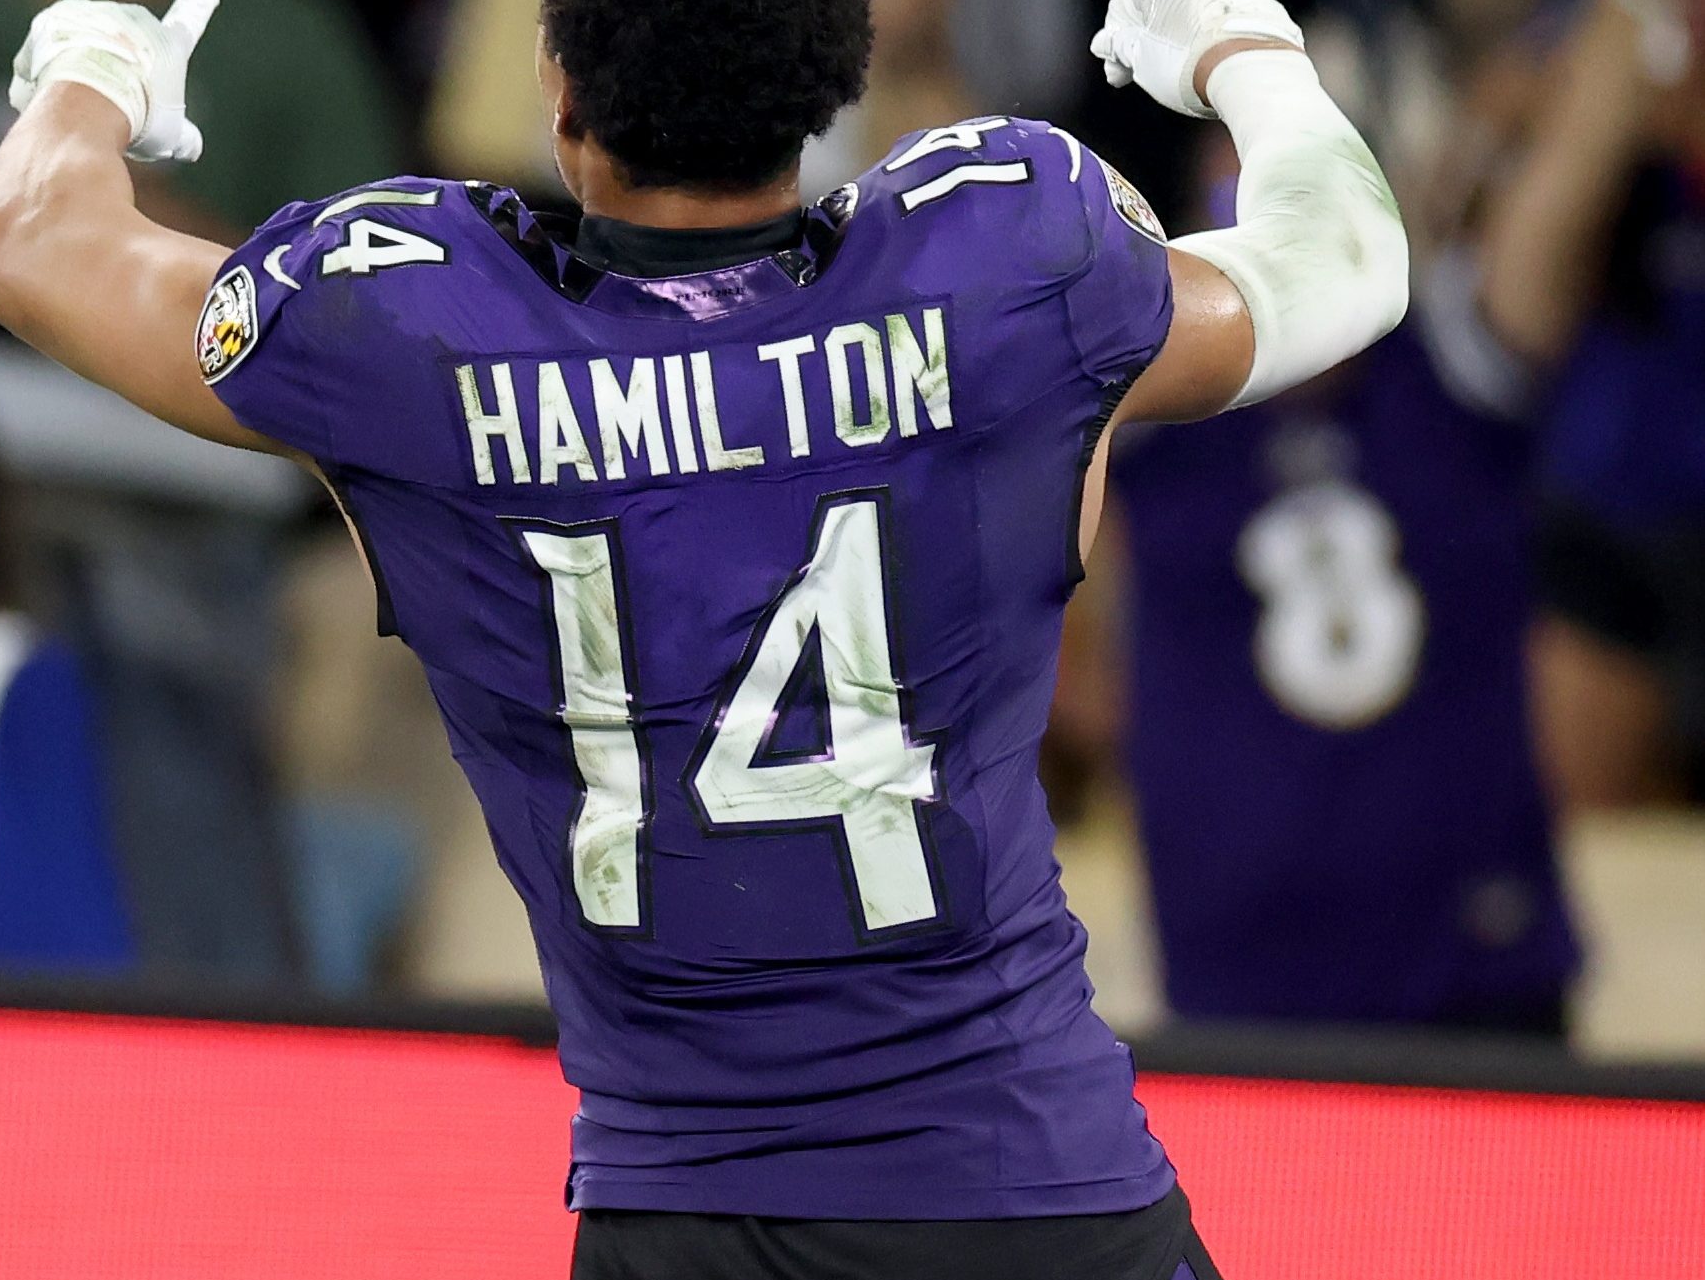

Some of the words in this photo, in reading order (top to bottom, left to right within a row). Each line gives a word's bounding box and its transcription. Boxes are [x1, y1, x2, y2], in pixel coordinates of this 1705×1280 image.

[310, 189, 447, 276] 14
[885, 117, 1029, 211] 14
[454, 307, 954, 486] HAMILTON
[1235, 491, 1425, 729] 8
[521, 499, 937, 932] 14
